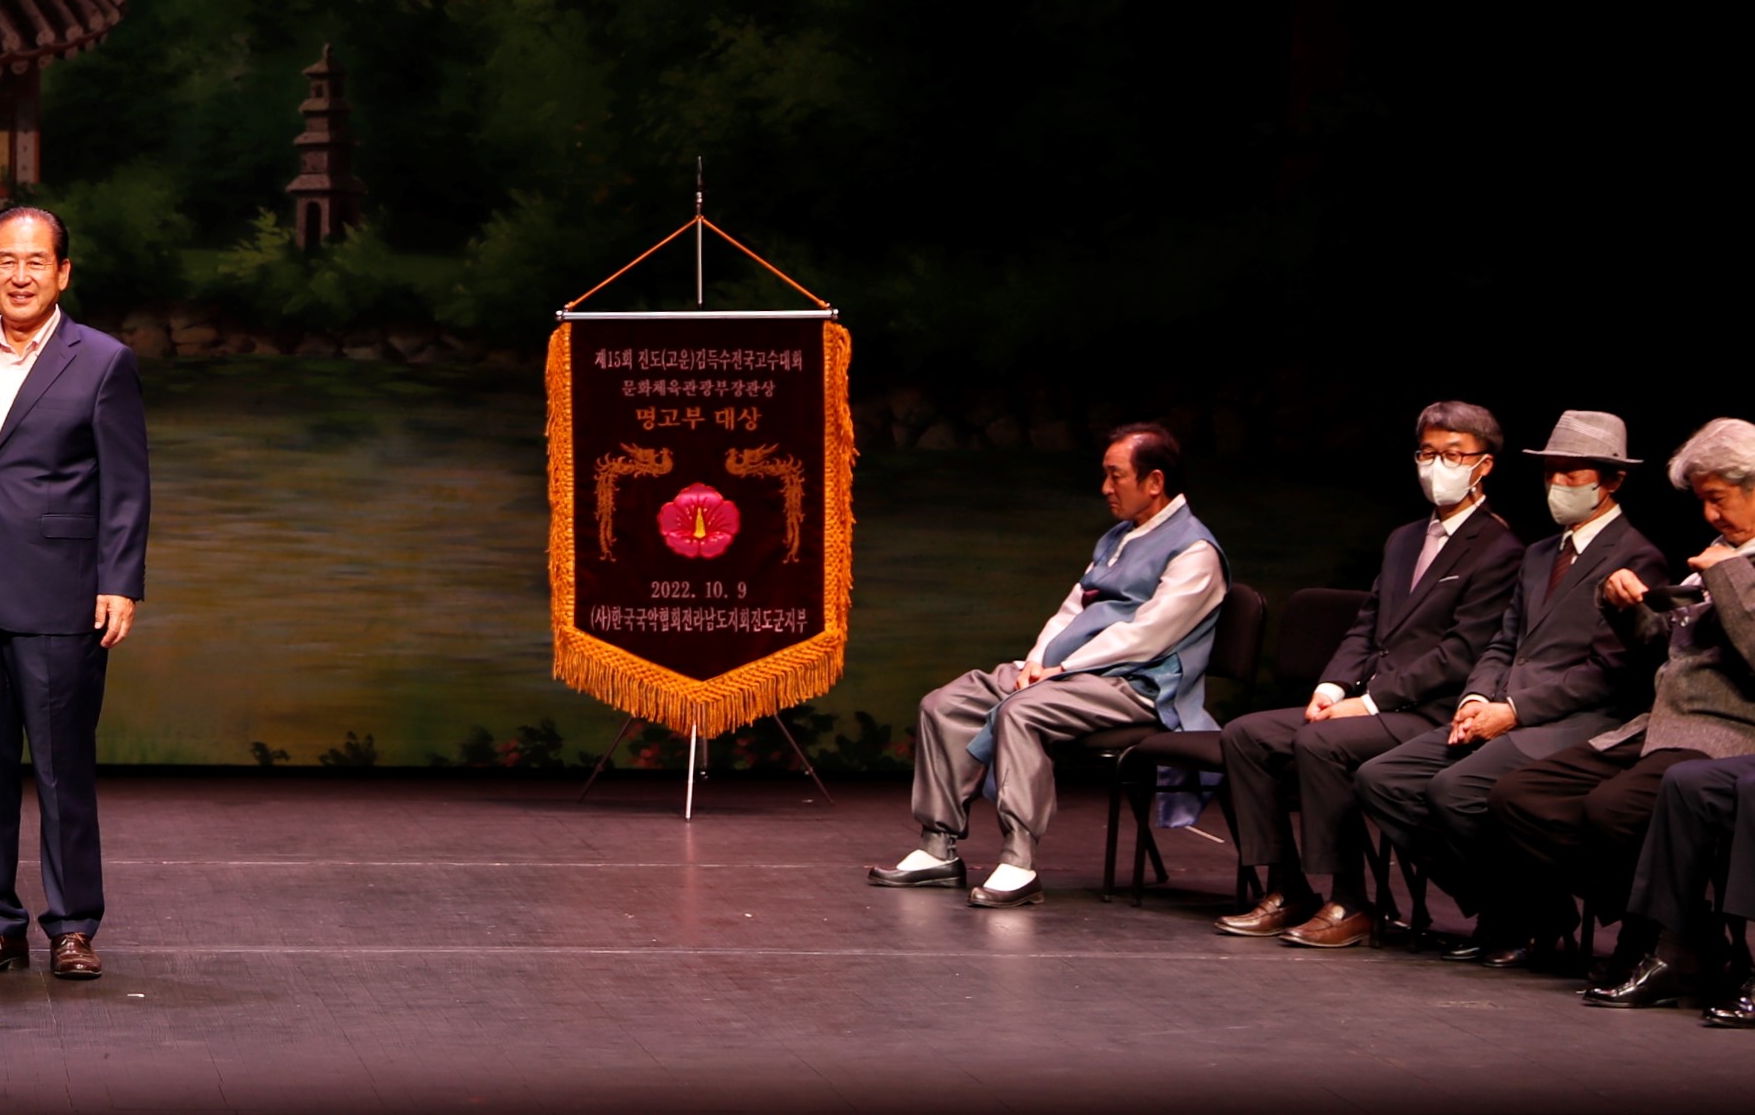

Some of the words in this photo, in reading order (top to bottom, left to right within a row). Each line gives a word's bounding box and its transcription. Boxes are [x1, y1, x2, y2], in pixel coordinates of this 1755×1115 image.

[594, 347, 633, 371] 제15회
[621, 378, 777, 398] 문화체육관광부장관상
[635, 405, 707, 431] 명고부
[714, 405, 763, 431] 대상
[650, 580, 696, 600] 2022.
[705, 580, 729, 600] 10.
[736, 581, 747, 600] 9
